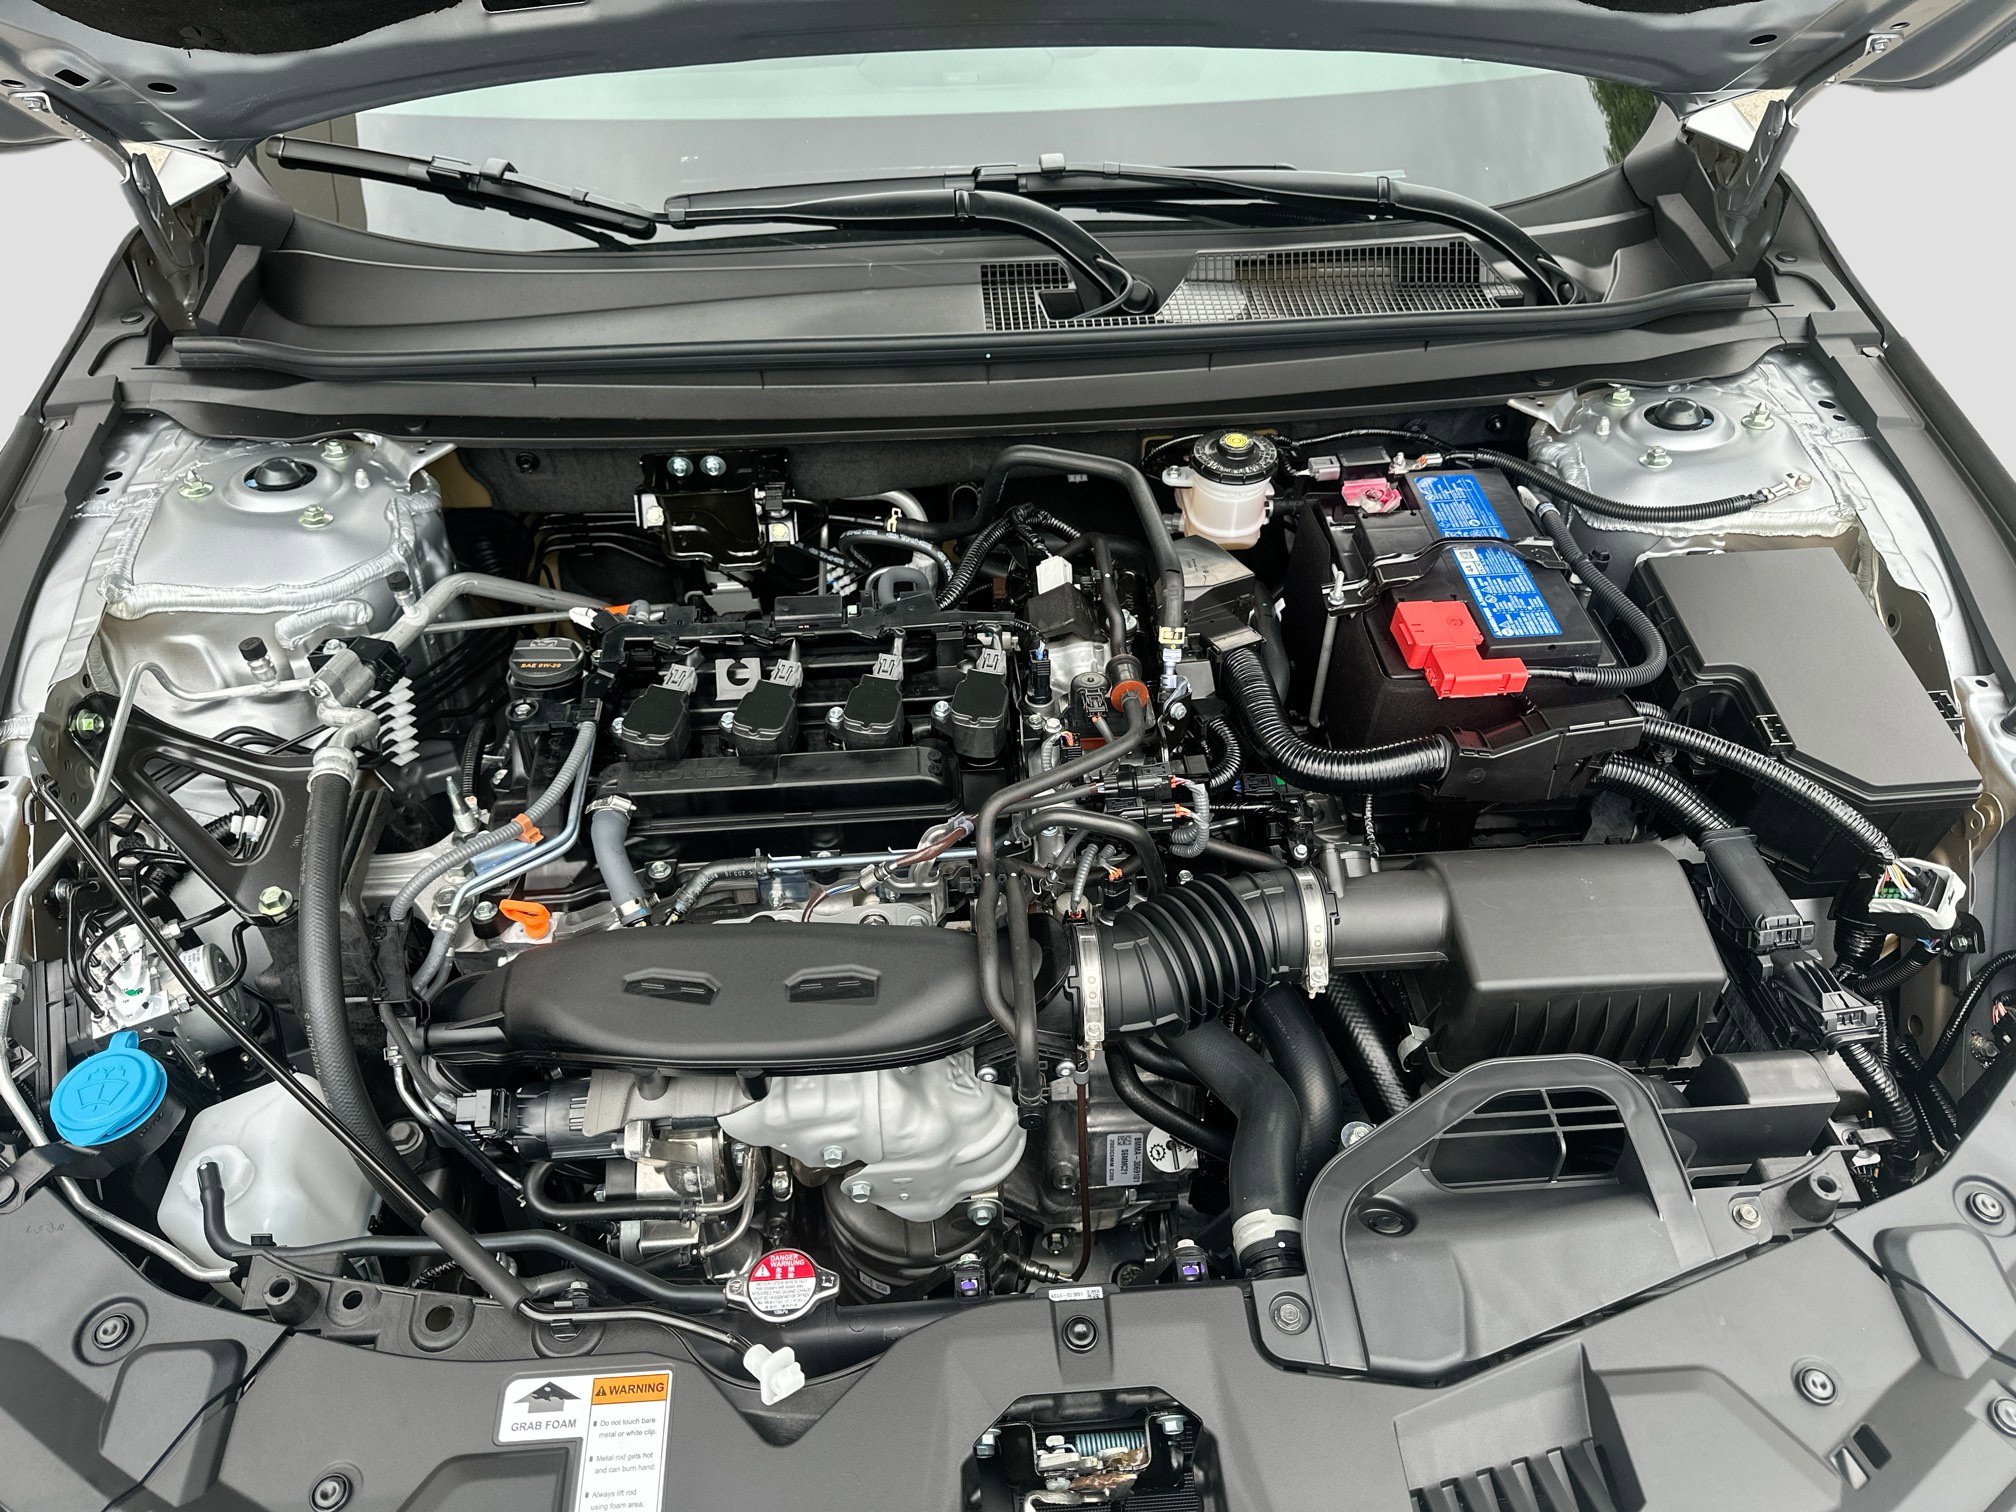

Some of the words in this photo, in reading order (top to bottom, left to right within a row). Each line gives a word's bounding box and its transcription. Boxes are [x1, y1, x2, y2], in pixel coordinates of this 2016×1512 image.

[770, 1259, 805, 1268] WARNUNG
[609, 1382, 665, 1395] WARNING
[511, 1421, 542, 1432] GRAB
[545, 1419, 577, 1430] FOAM
[627, 1453, 641, 1461] gets
[592, 1491, 616, 1499] Always
